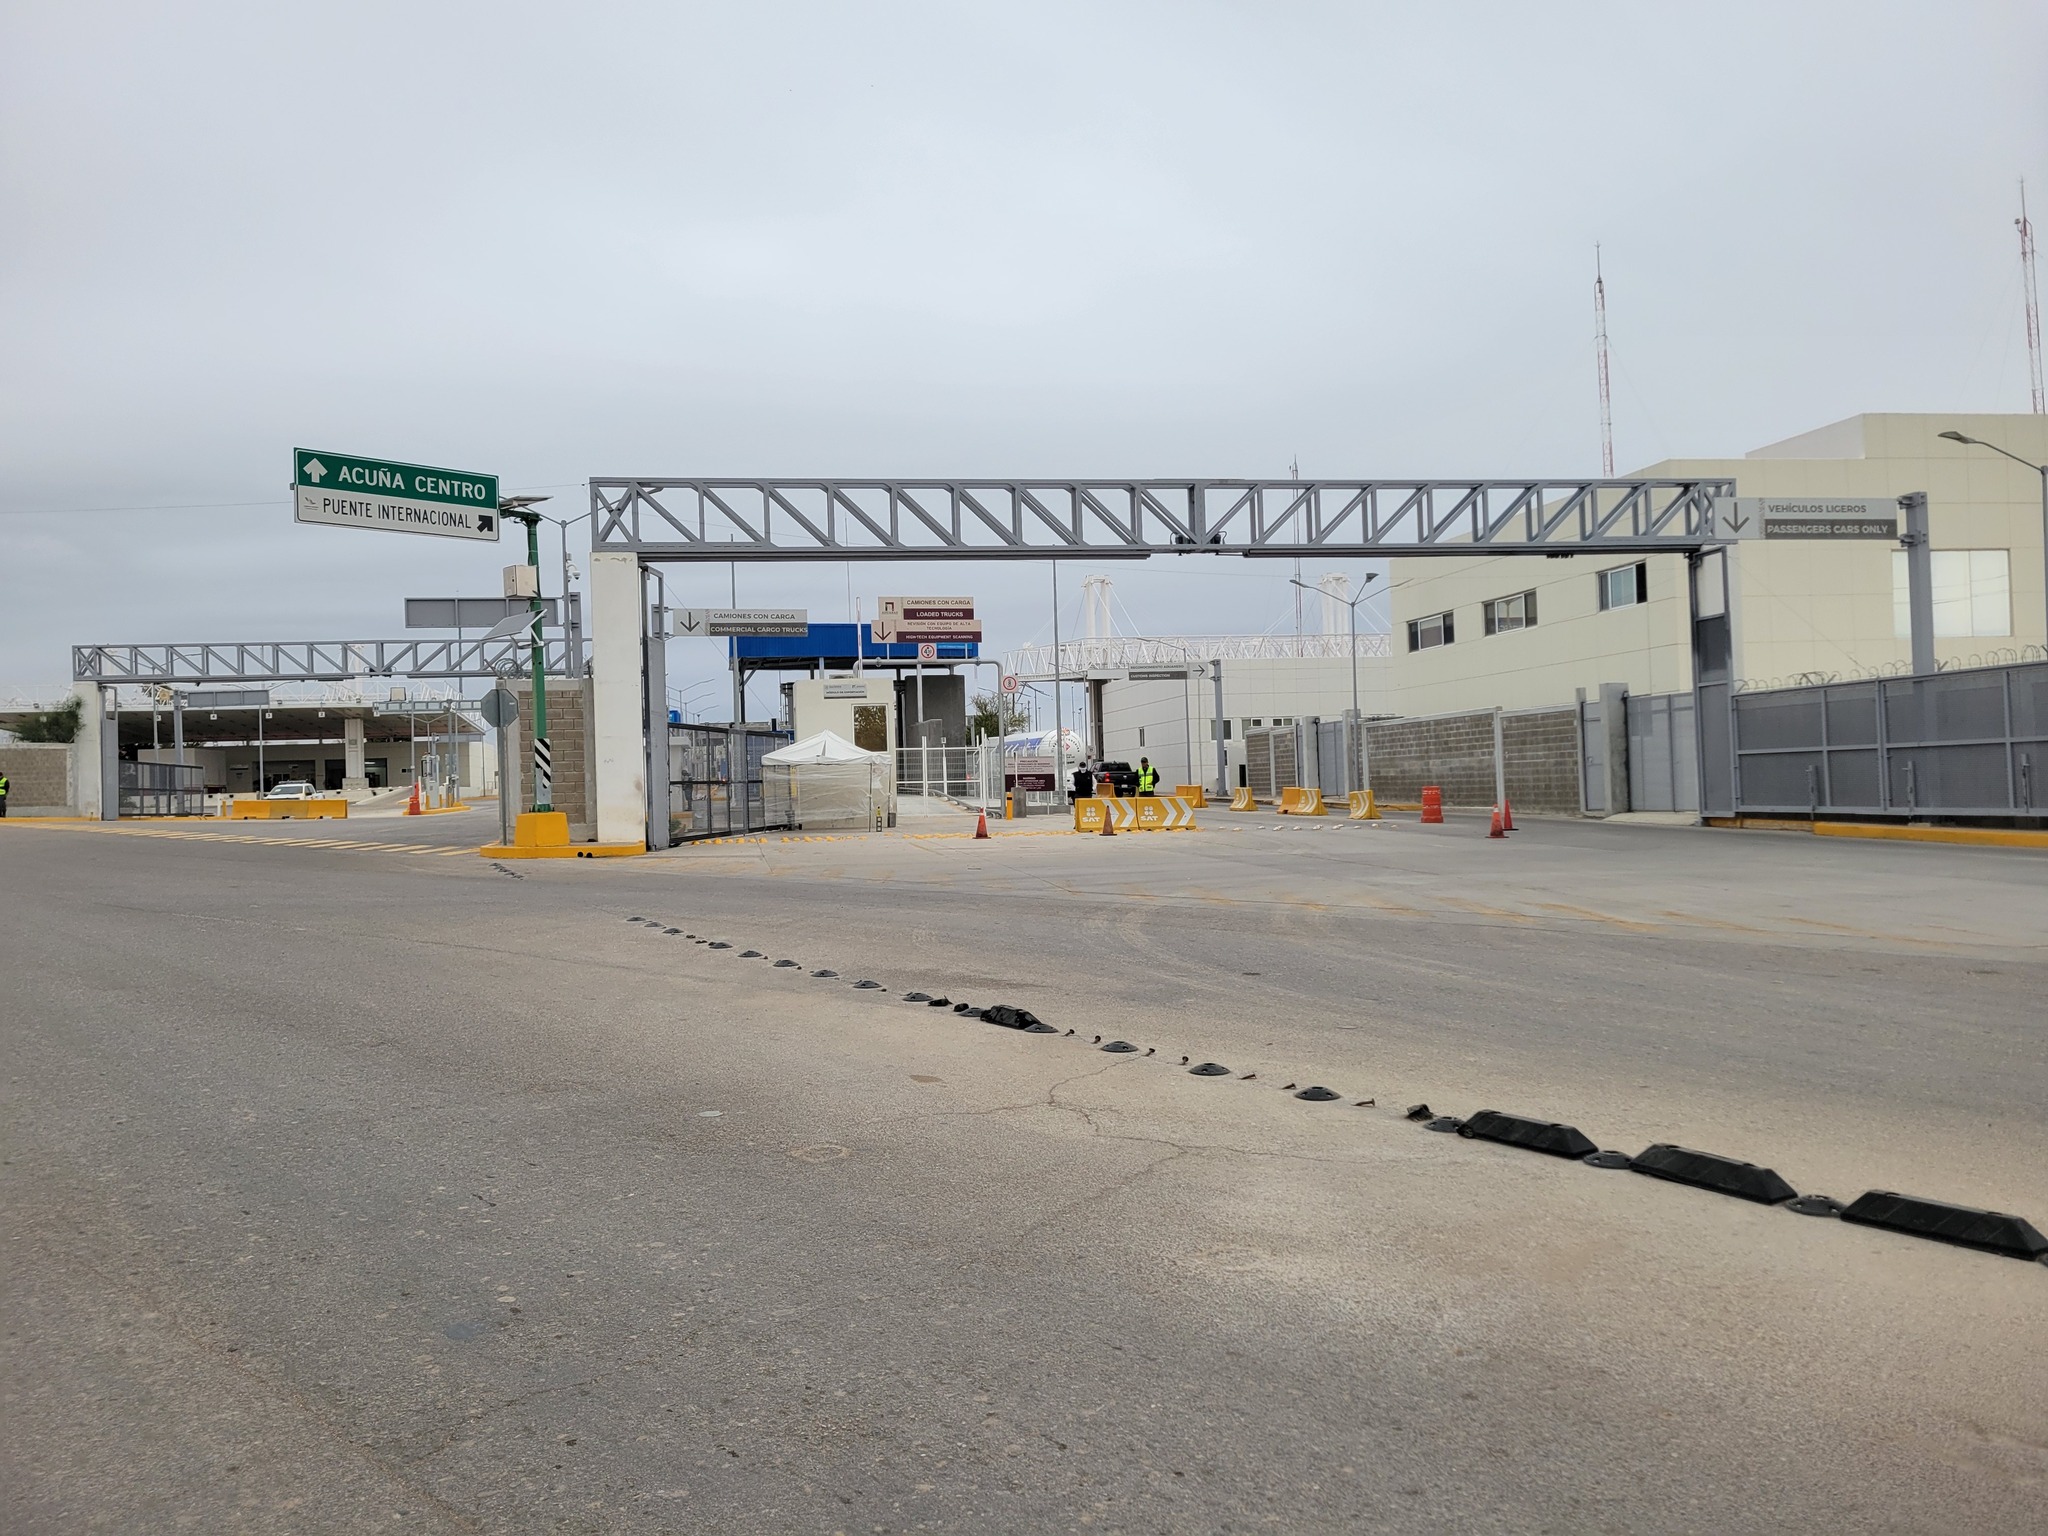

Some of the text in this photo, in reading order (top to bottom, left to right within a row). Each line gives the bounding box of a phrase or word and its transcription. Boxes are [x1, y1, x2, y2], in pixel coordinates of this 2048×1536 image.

[338, 466, 486, 500] ACUÑA CENTRO
[323, 498, 372, 518] PUENTE
[378, 504, 471, 529] INTERNACIONAL
[1768, 503, 1867, 513] VEHÍCULOS LIGEROS
[1767, 525, 1888, 534] PASSENGERS CARS ONLY
